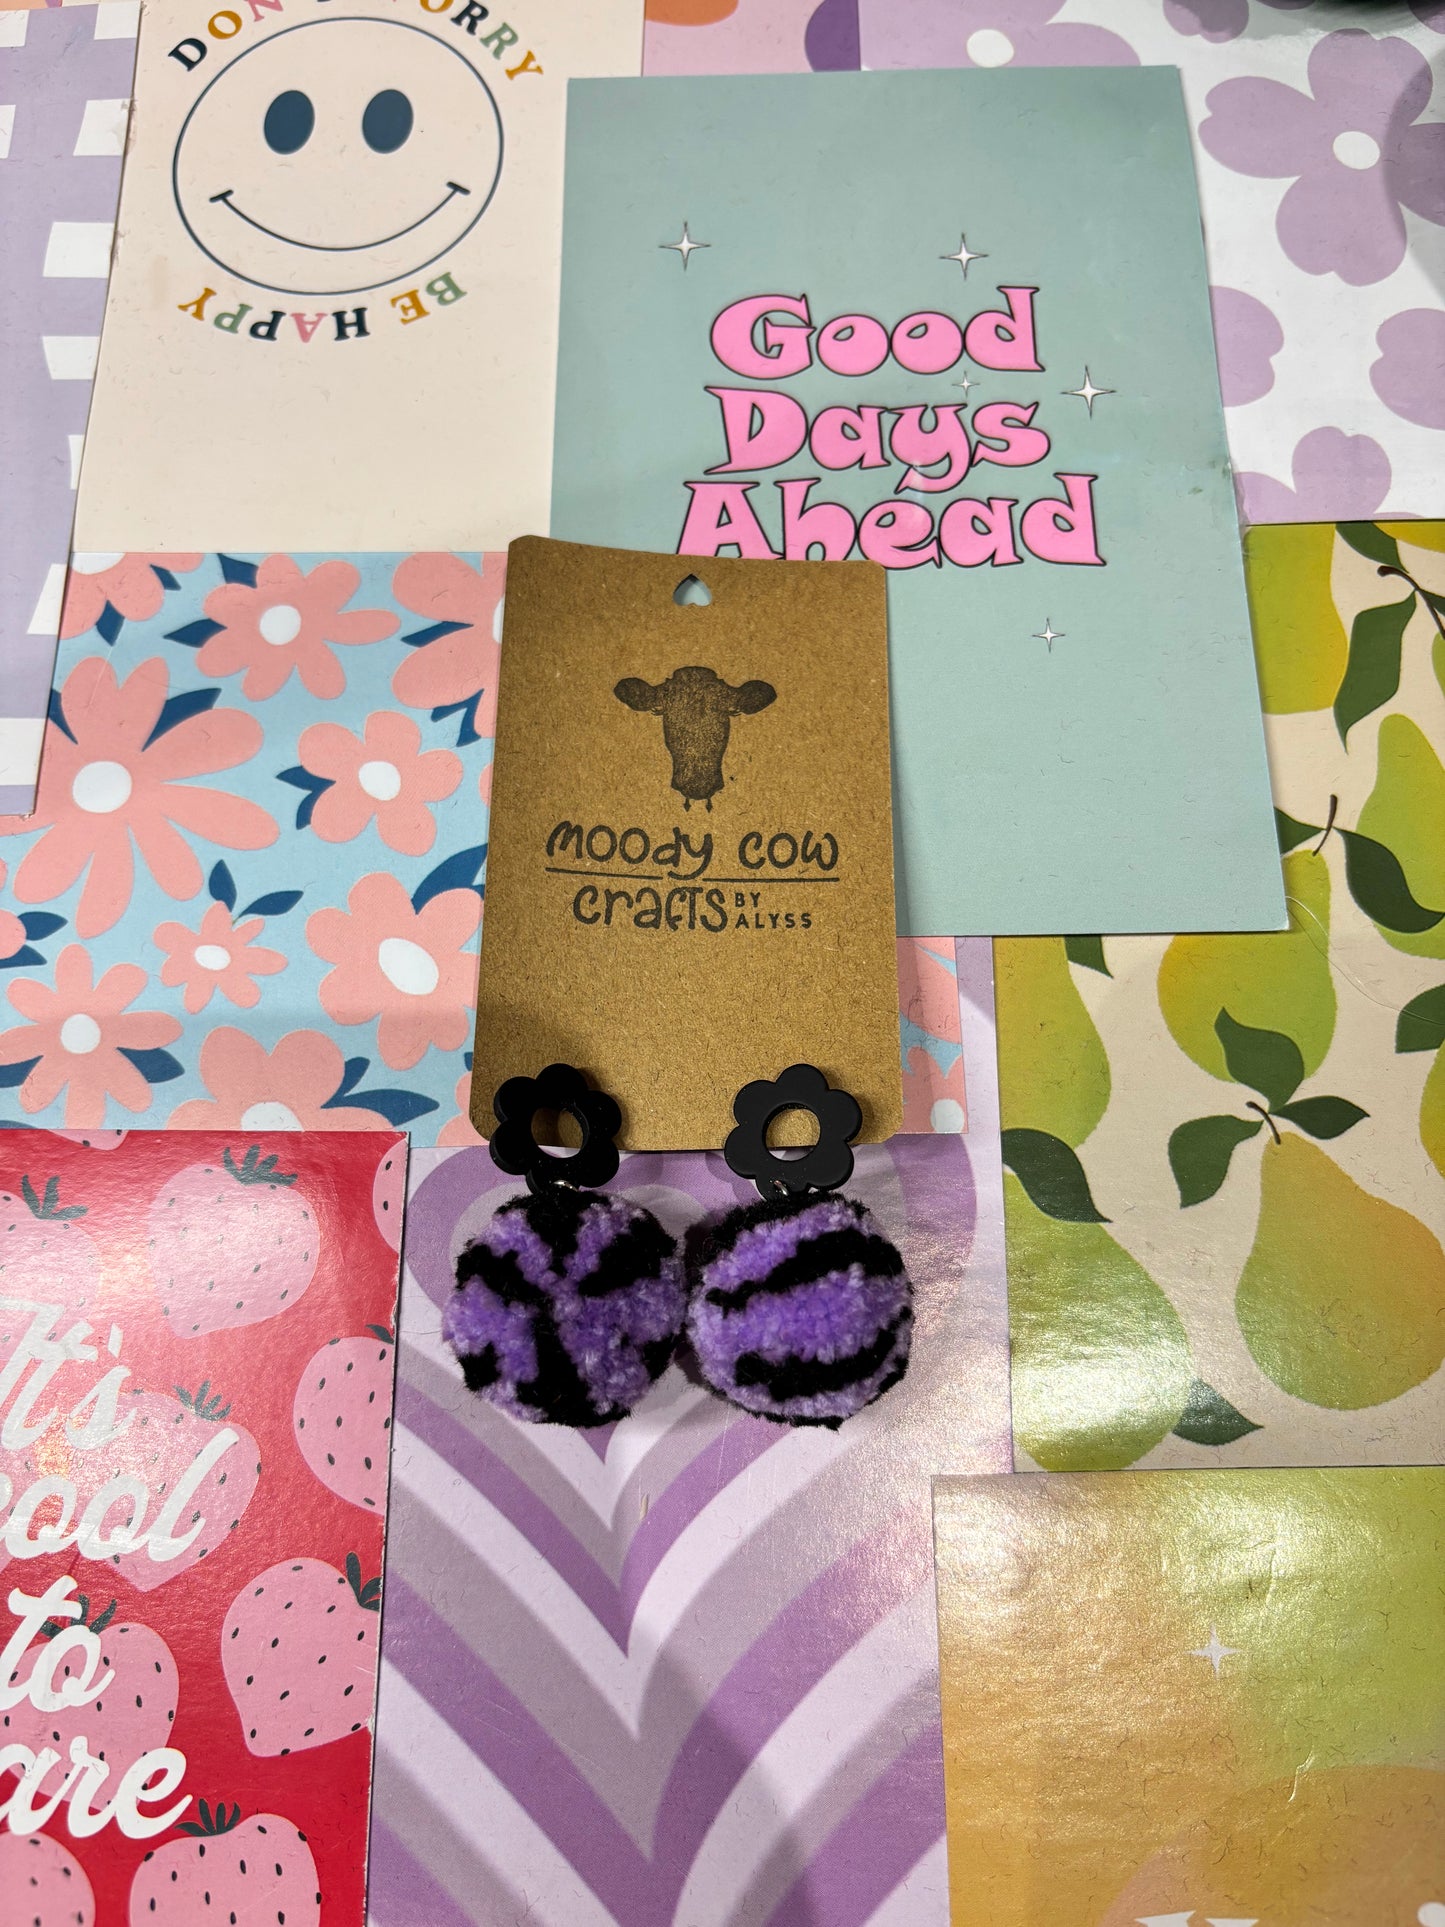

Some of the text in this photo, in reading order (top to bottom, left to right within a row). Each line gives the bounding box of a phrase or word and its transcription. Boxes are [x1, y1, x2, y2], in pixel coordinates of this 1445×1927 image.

[168, 0, 331, 72] DON
[179, 272, 467, 343] BE HAPPY
[710, 286, 1046, 380] Good
[704, 386, 1051, 494] Days
[676, 472, 1106, 570] Ahead
[734, 892, 760, 907] BY
[735, 913, 812, 929] ALYSS
[0, 1298, 138, 1450] It's
[0, 1427, 240, 1561] ool
[0, 1575, 116, 1712] to
